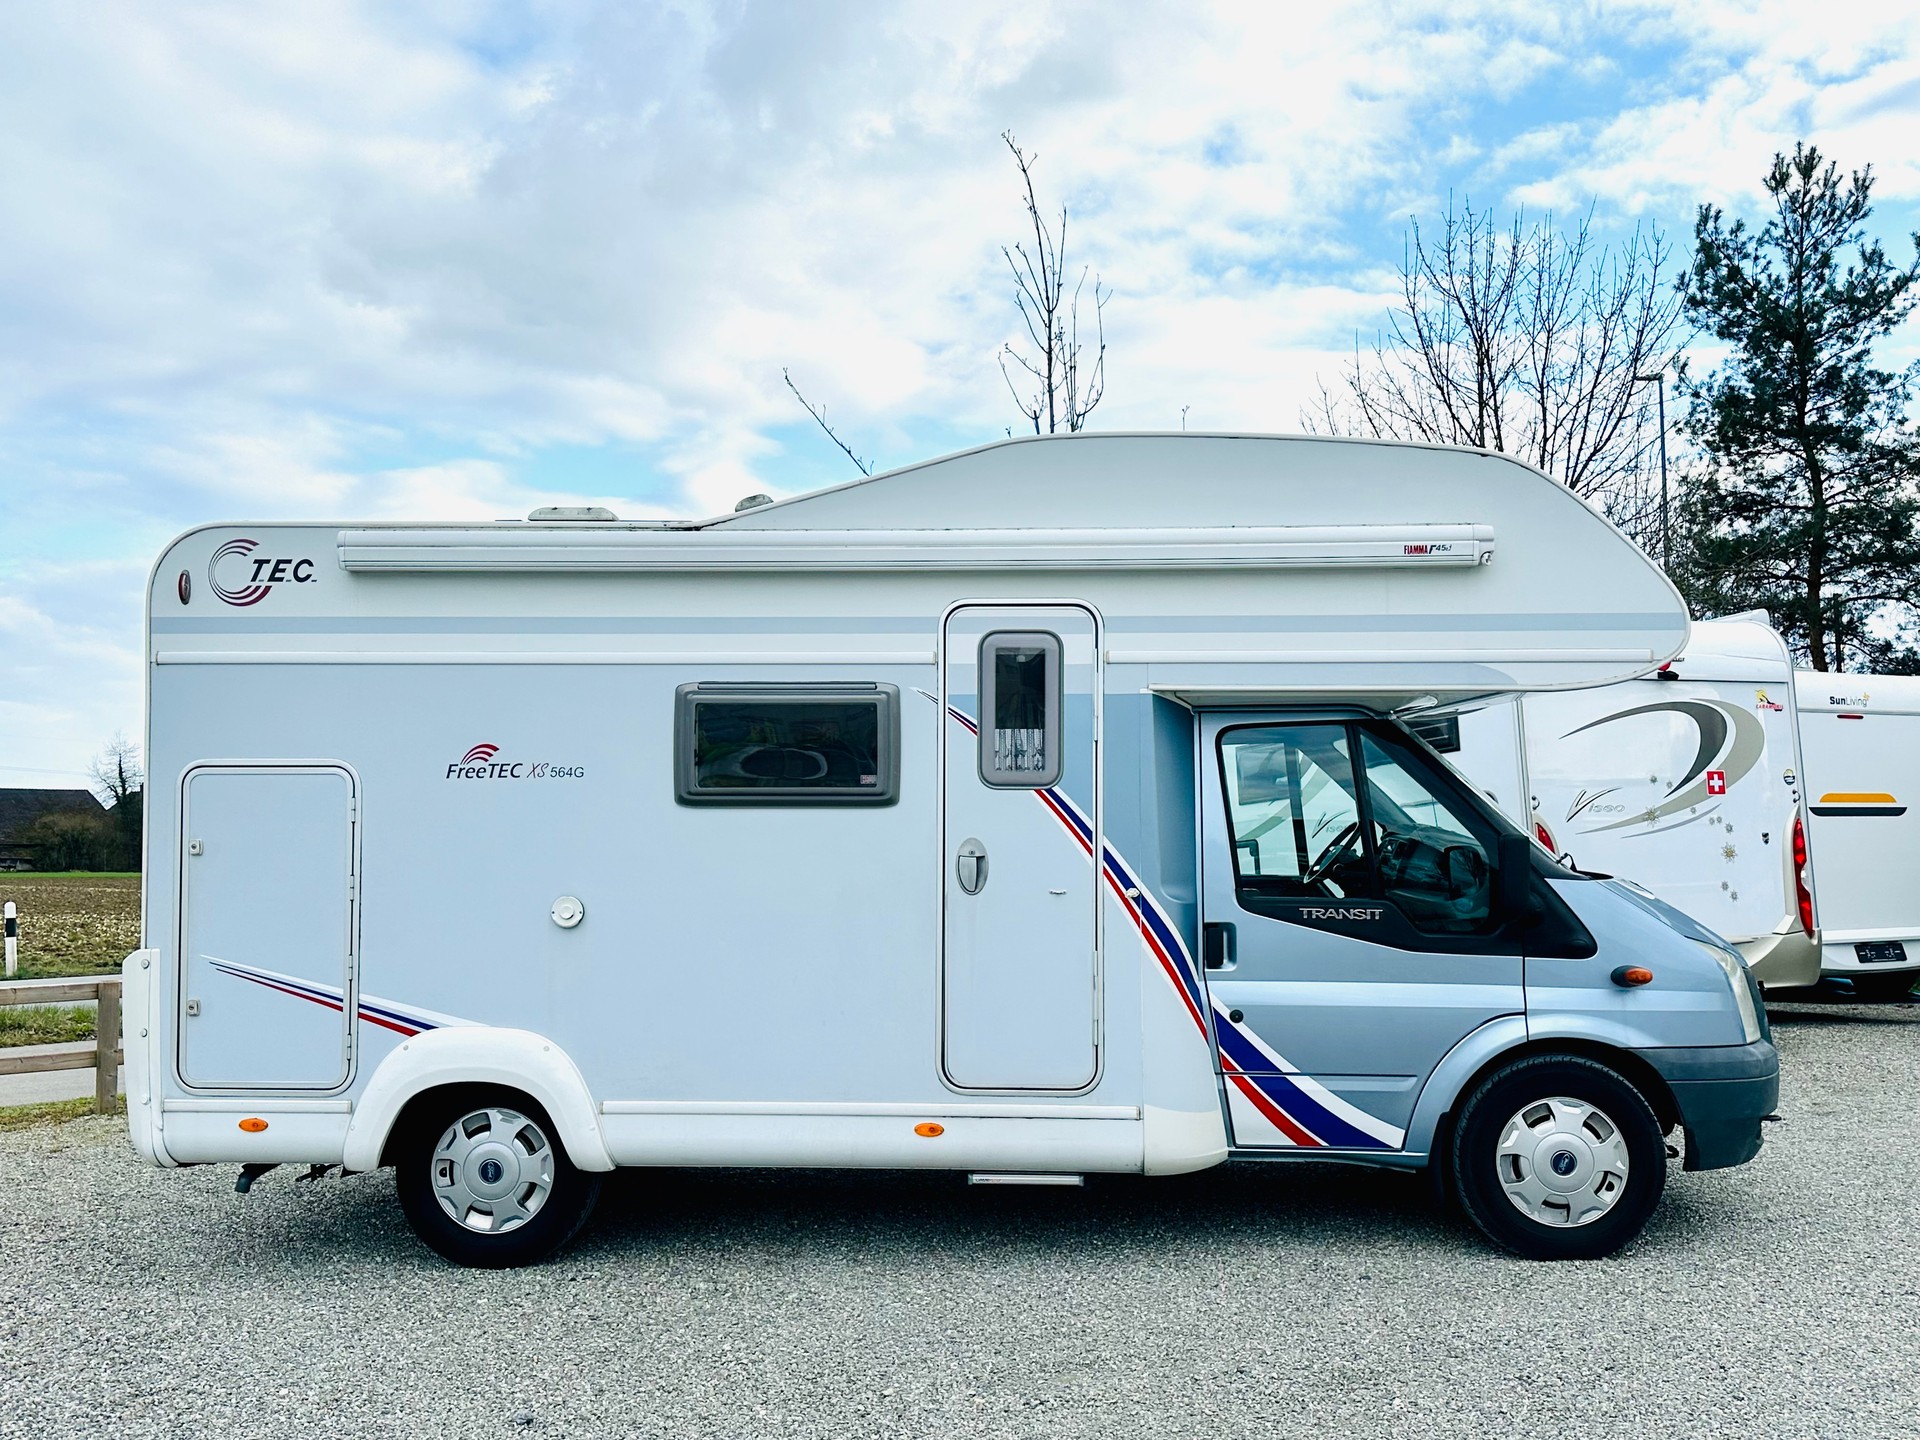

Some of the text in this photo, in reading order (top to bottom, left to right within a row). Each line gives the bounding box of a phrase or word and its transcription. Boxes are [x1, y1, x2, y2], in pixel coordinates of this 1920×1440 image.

[1404, 544, 1428, 555] FIAMMA
[250, 558, 318, 583] T.E.C.
[1829, 695, 1868, 708] SunLiving
[446, 762, 584, 779] FreeTEC XS 564G
[1298, 907, 1384, 920] TRANSIT
